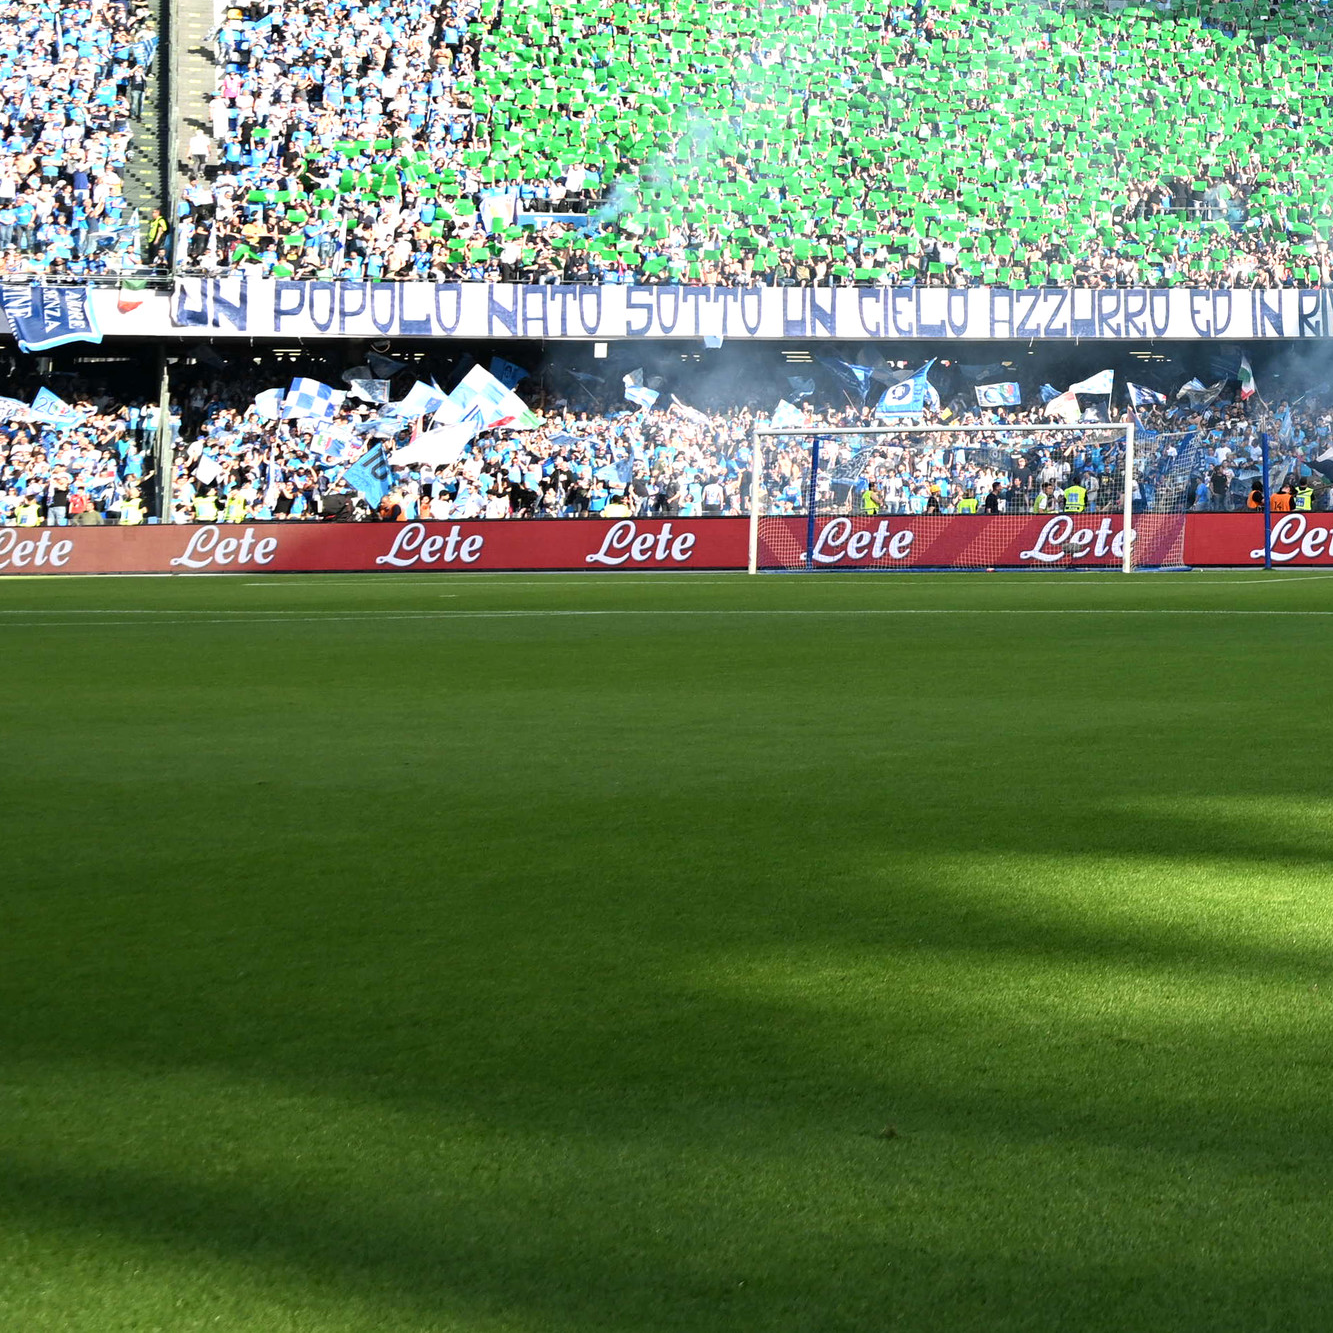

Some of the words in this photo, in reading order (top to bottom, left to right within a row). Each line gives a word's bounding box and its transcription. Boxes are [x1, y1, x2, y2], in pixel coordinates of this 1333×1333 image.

[273, 282, 462, 334] POPOLO
[487, 282, 603, 335] NATO
[626, 286, 761, 336] SOTTO
[783, 287, 836, 336] UN
[859, 287, 968, 336] CIELO
[990, 288, 1169, 336] AZZURRO
[1190, 288, 1232, 336] ED
[1253, 288, 1283, 336] IN
[170, 525, 277, 568] Lete
[376, 522, 483, 566] Lete
[585, 519, 696, 565] Lete
[800, 517, 914, 563] Lete
[1020, 515, 1136, 562] Lete
